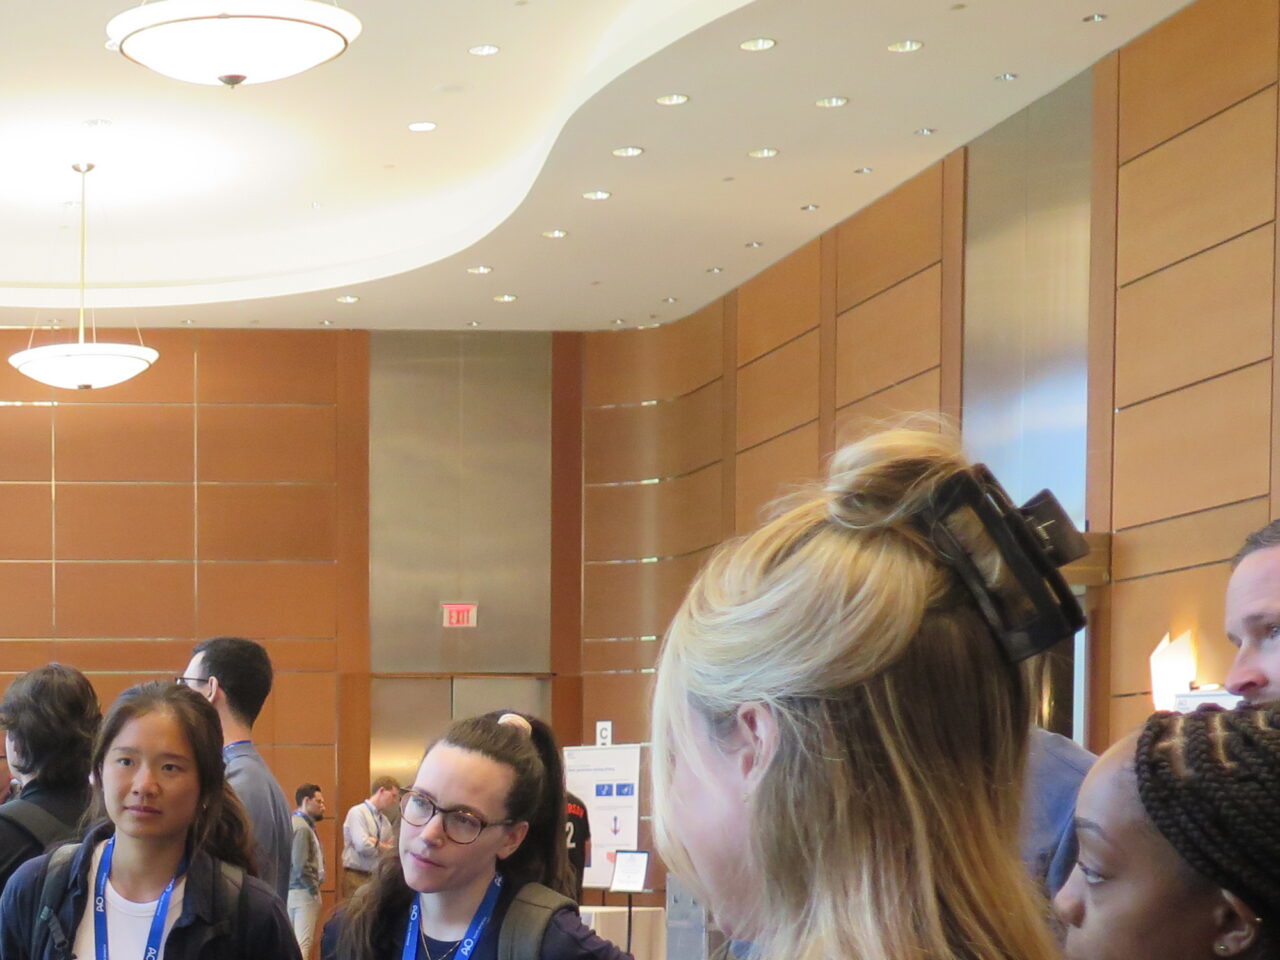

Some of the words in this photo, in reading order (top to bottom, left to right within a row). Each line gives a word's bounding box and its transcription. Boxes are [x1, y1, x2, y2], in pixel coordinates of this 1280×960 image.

[448, 608, 471, 625] EXIT
[599, 728, 609, 740] C
[96, 896, 105, 913] AO
[460, 938, 474, 956] AO
